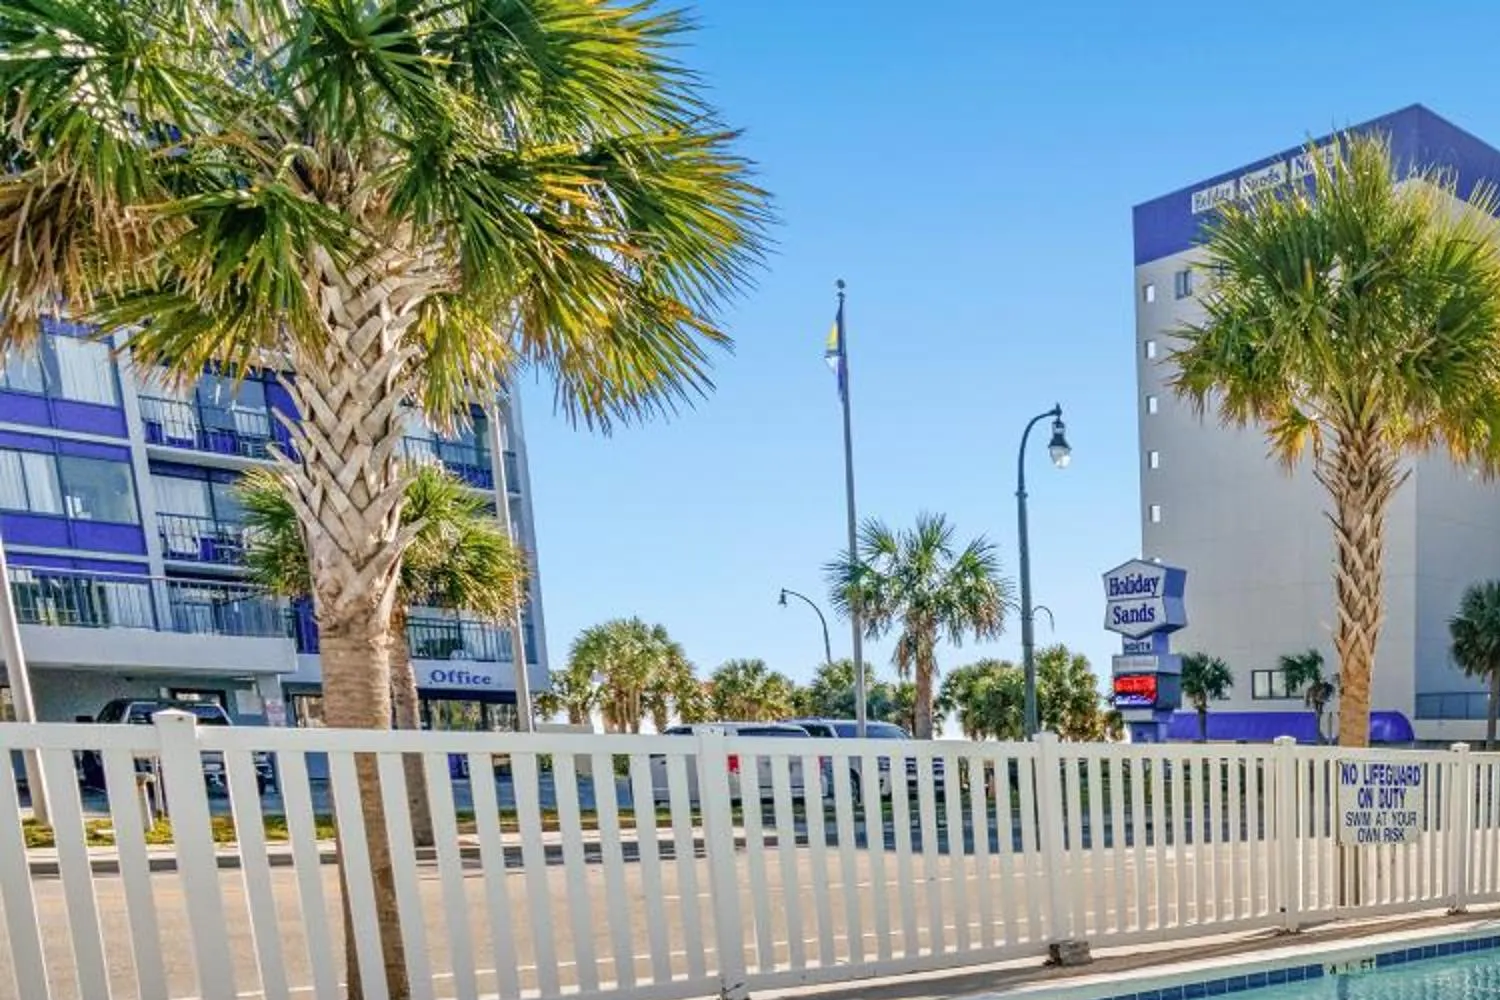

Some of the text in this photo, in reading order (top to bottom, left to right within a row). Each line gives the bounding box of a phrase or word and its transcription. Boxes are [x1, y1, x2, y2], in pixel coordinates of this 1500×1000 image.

[1109, 575, 1158, 597] Holiday
[1113, 603, 1155, 625] Sands
[430, 669, 492, 685] Office
[1341, 764, 1420, 786] NO LIFEGUARD
[1358, 787, 1407, 809] ON DUTY
[1346, 811, 1416, 827] SWIM AT YOUR
[1358, 827, 1405, 842] OWN RISK
